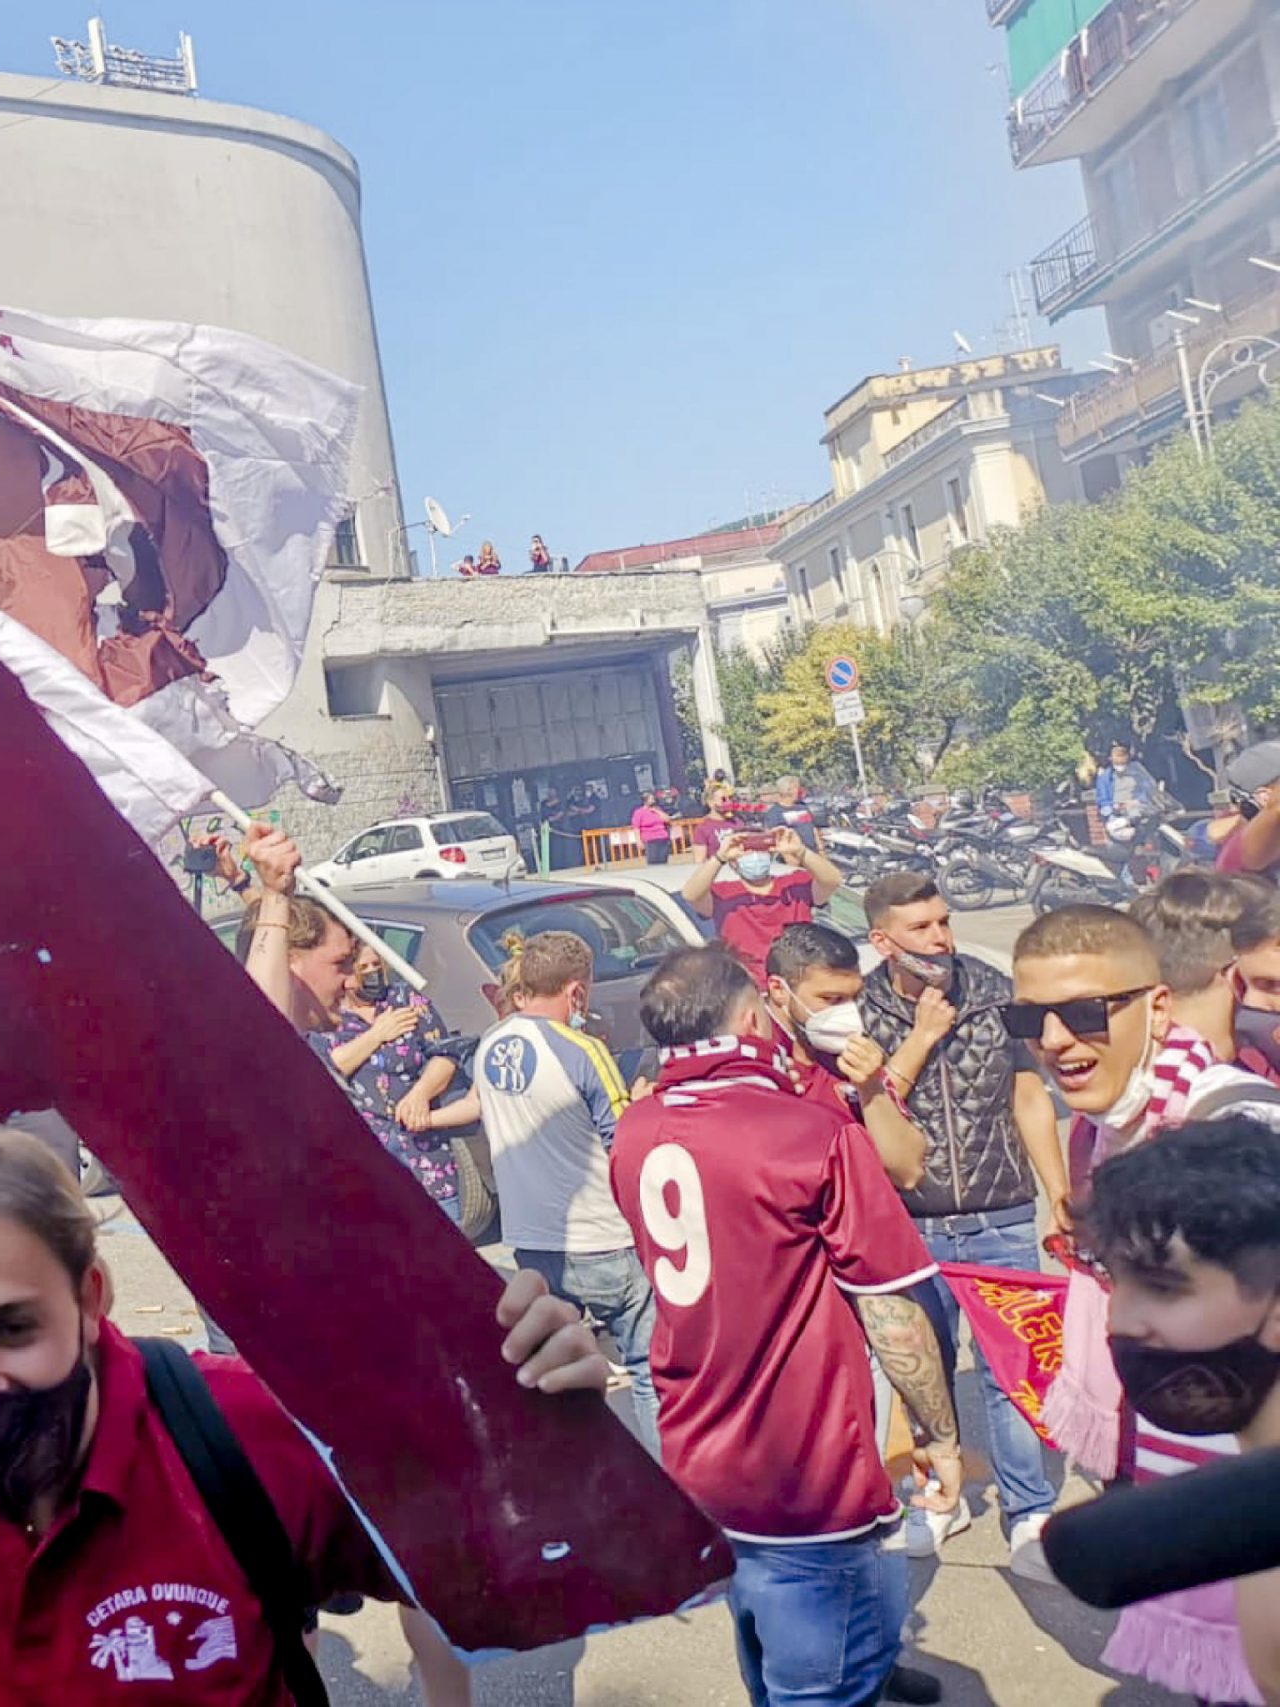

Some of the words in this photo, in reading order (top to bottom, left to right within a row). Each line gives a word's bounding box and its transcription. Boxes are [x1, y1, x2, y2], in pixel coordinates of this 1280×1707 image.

[640, 1143, 712, 1307] 9
[86, 1585, 148, 1628] CETARA
[151, 1582, 230, 1616] OVUNQUE
